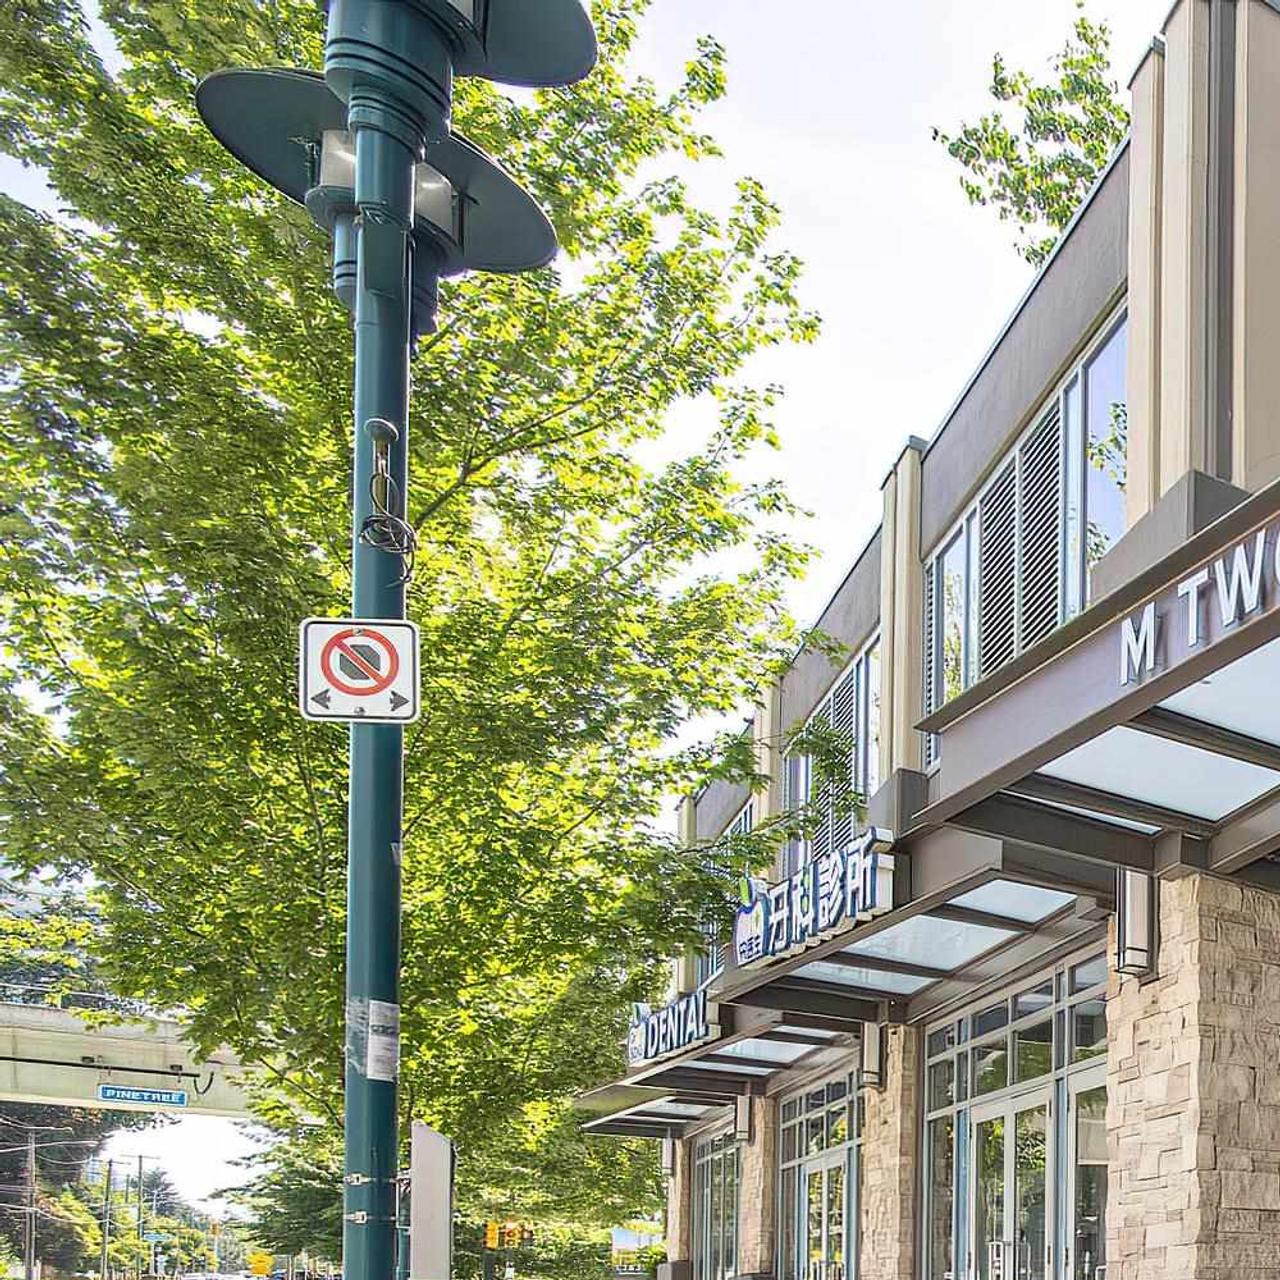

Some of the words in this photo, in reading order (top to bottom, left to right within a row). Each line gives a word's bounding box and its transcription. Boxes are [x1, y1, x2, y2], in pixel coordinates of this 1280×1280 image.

[1120, 601, 1156, 686] M
[767, 827, 877, 955] 牙科診所
[647, 989, 707, 1058] DENTAL
